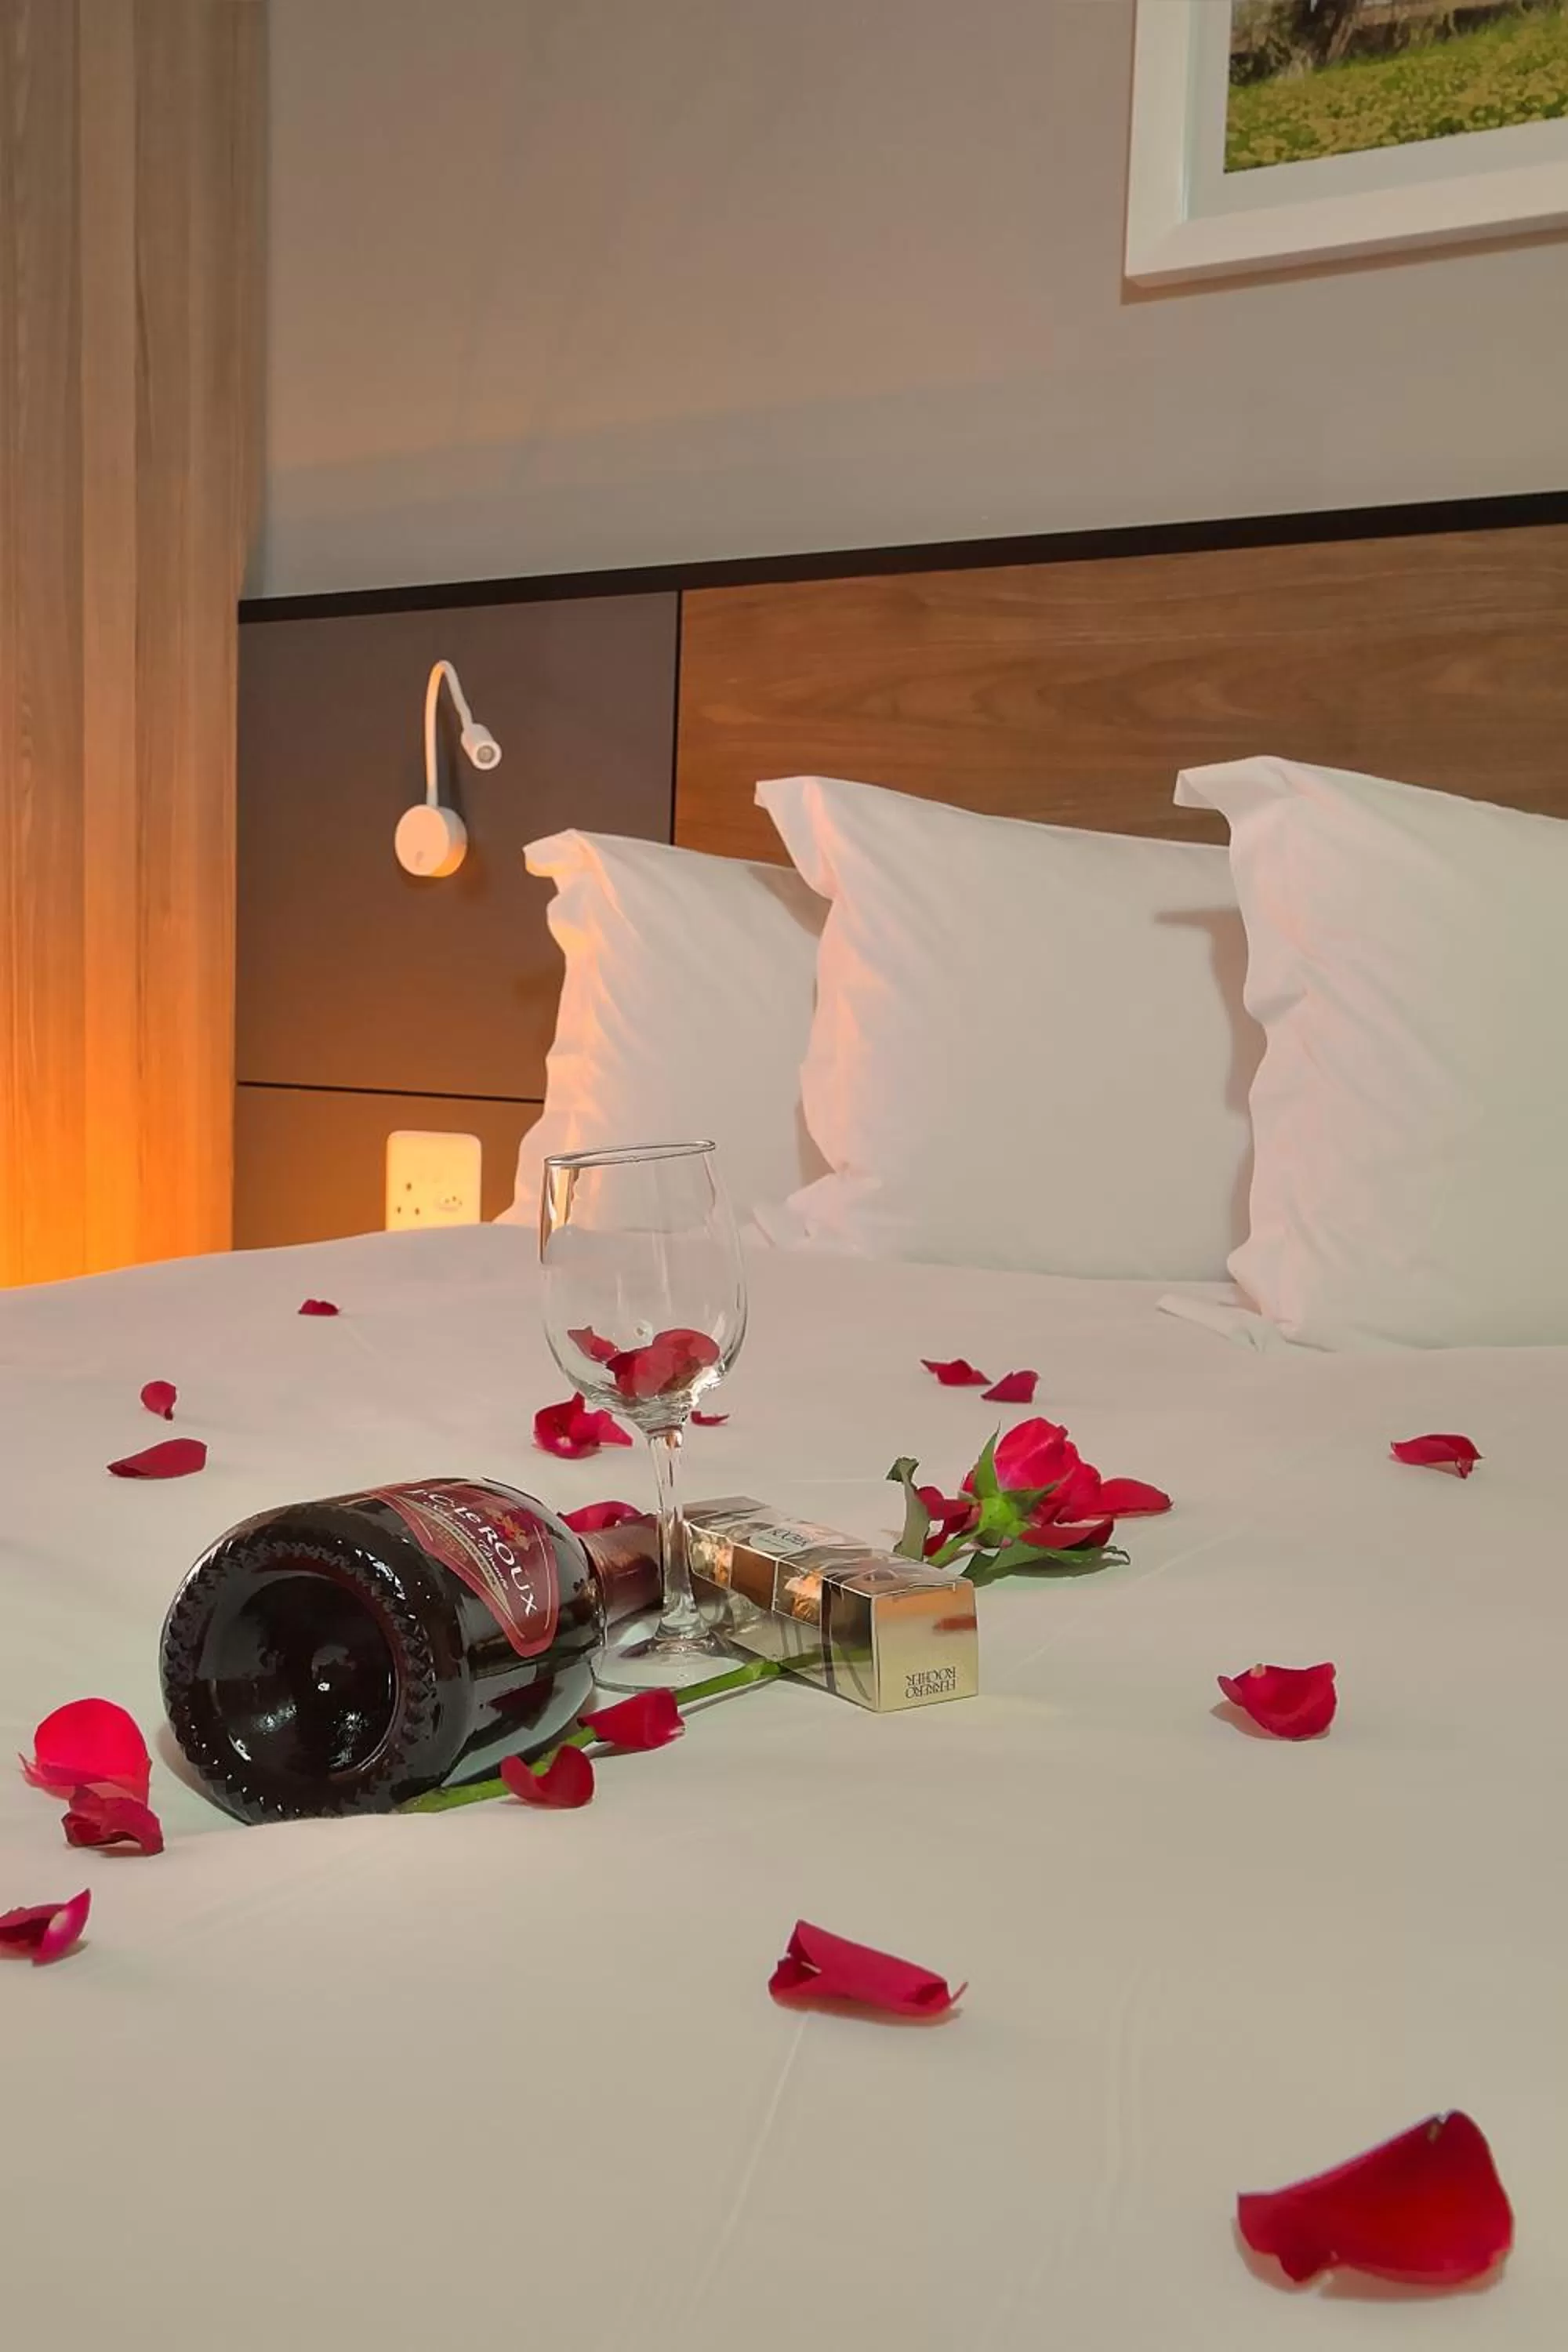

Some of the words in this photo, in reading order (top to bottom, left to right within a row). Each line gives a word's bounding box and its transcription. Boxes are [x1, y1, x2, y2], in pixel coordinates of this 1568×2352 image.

[477, 1526, 538, 1617] ROUX
[906, 1667, 956, 1686] ROCHER
[906, 1679, 956, 1699] FERRERO
